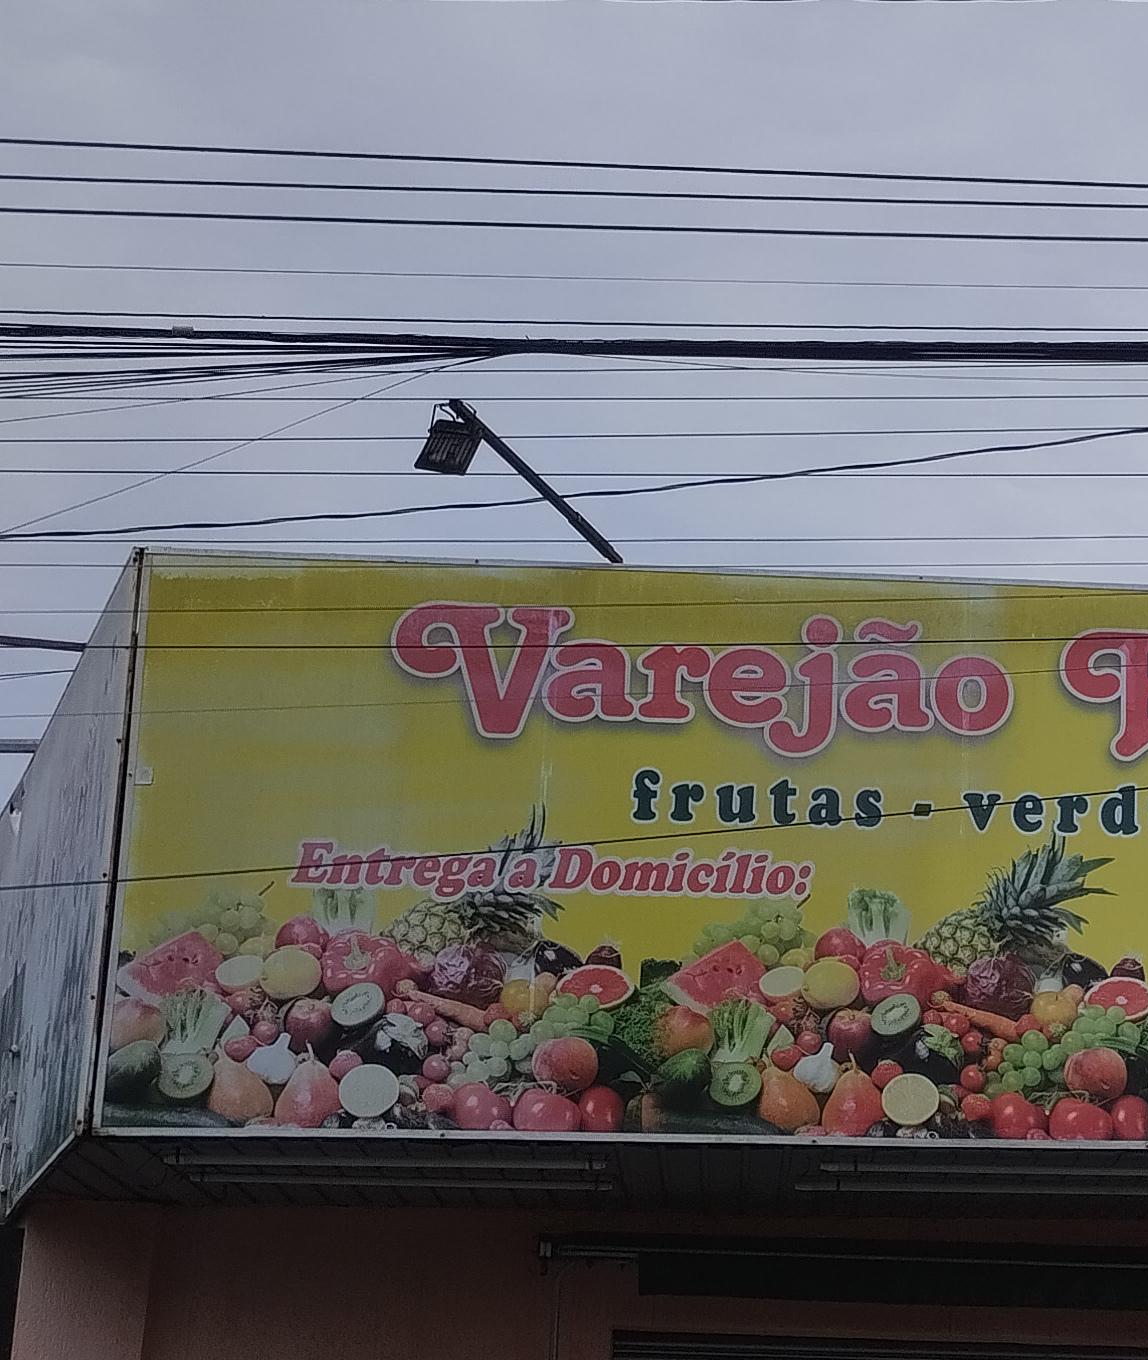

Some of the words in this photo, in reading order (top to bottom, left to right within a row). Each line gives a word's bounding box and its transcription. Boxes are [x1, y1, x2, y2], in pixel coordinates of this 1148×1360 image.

[391, 600, 1013, 757] Varejão
[632, 769, 882, 826] frutas
[290, 841, 495, 896] Entrega
[550, 846, 813, 896] Domicílio:
